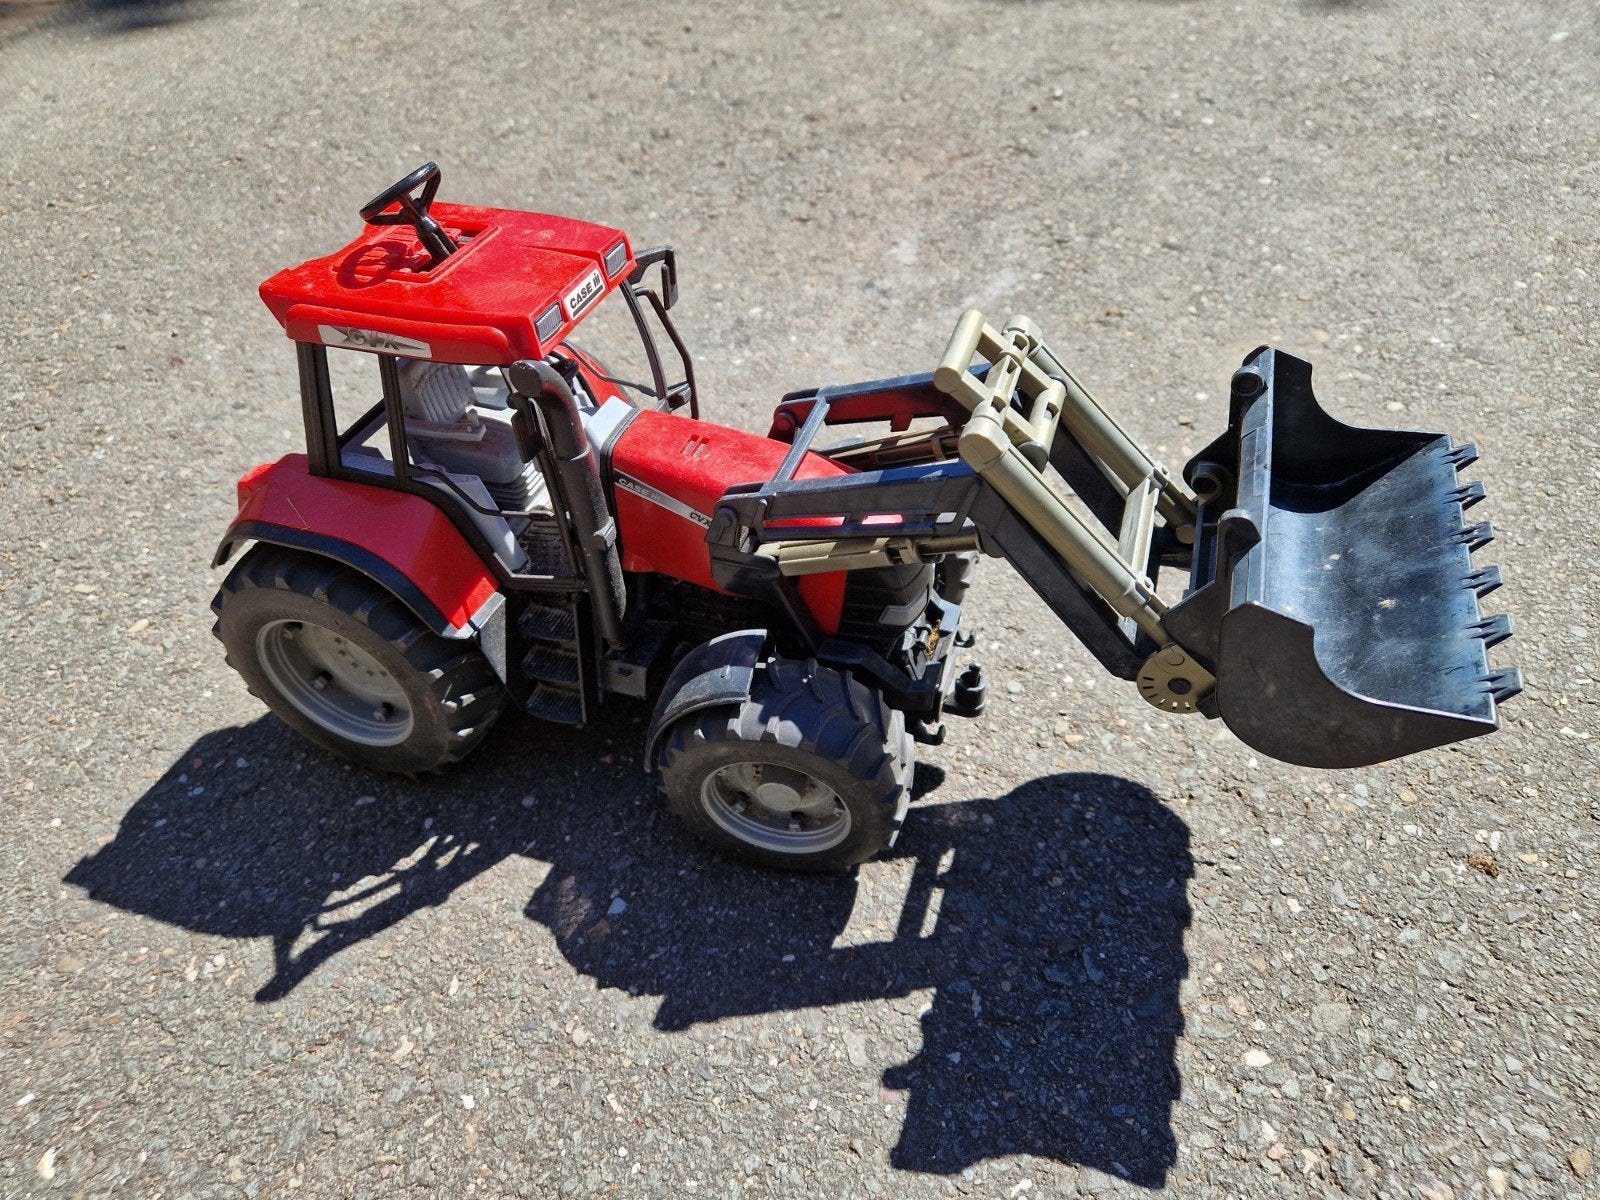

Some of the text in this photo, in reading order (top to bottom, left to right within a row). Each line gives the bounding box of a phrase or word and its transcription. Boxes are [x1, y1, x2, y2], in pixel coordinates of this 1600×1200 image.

[570, 282, 593, 309] CASE
[618, 478, 650, 497] CASE
[690, 512, 712, 527] CVX
